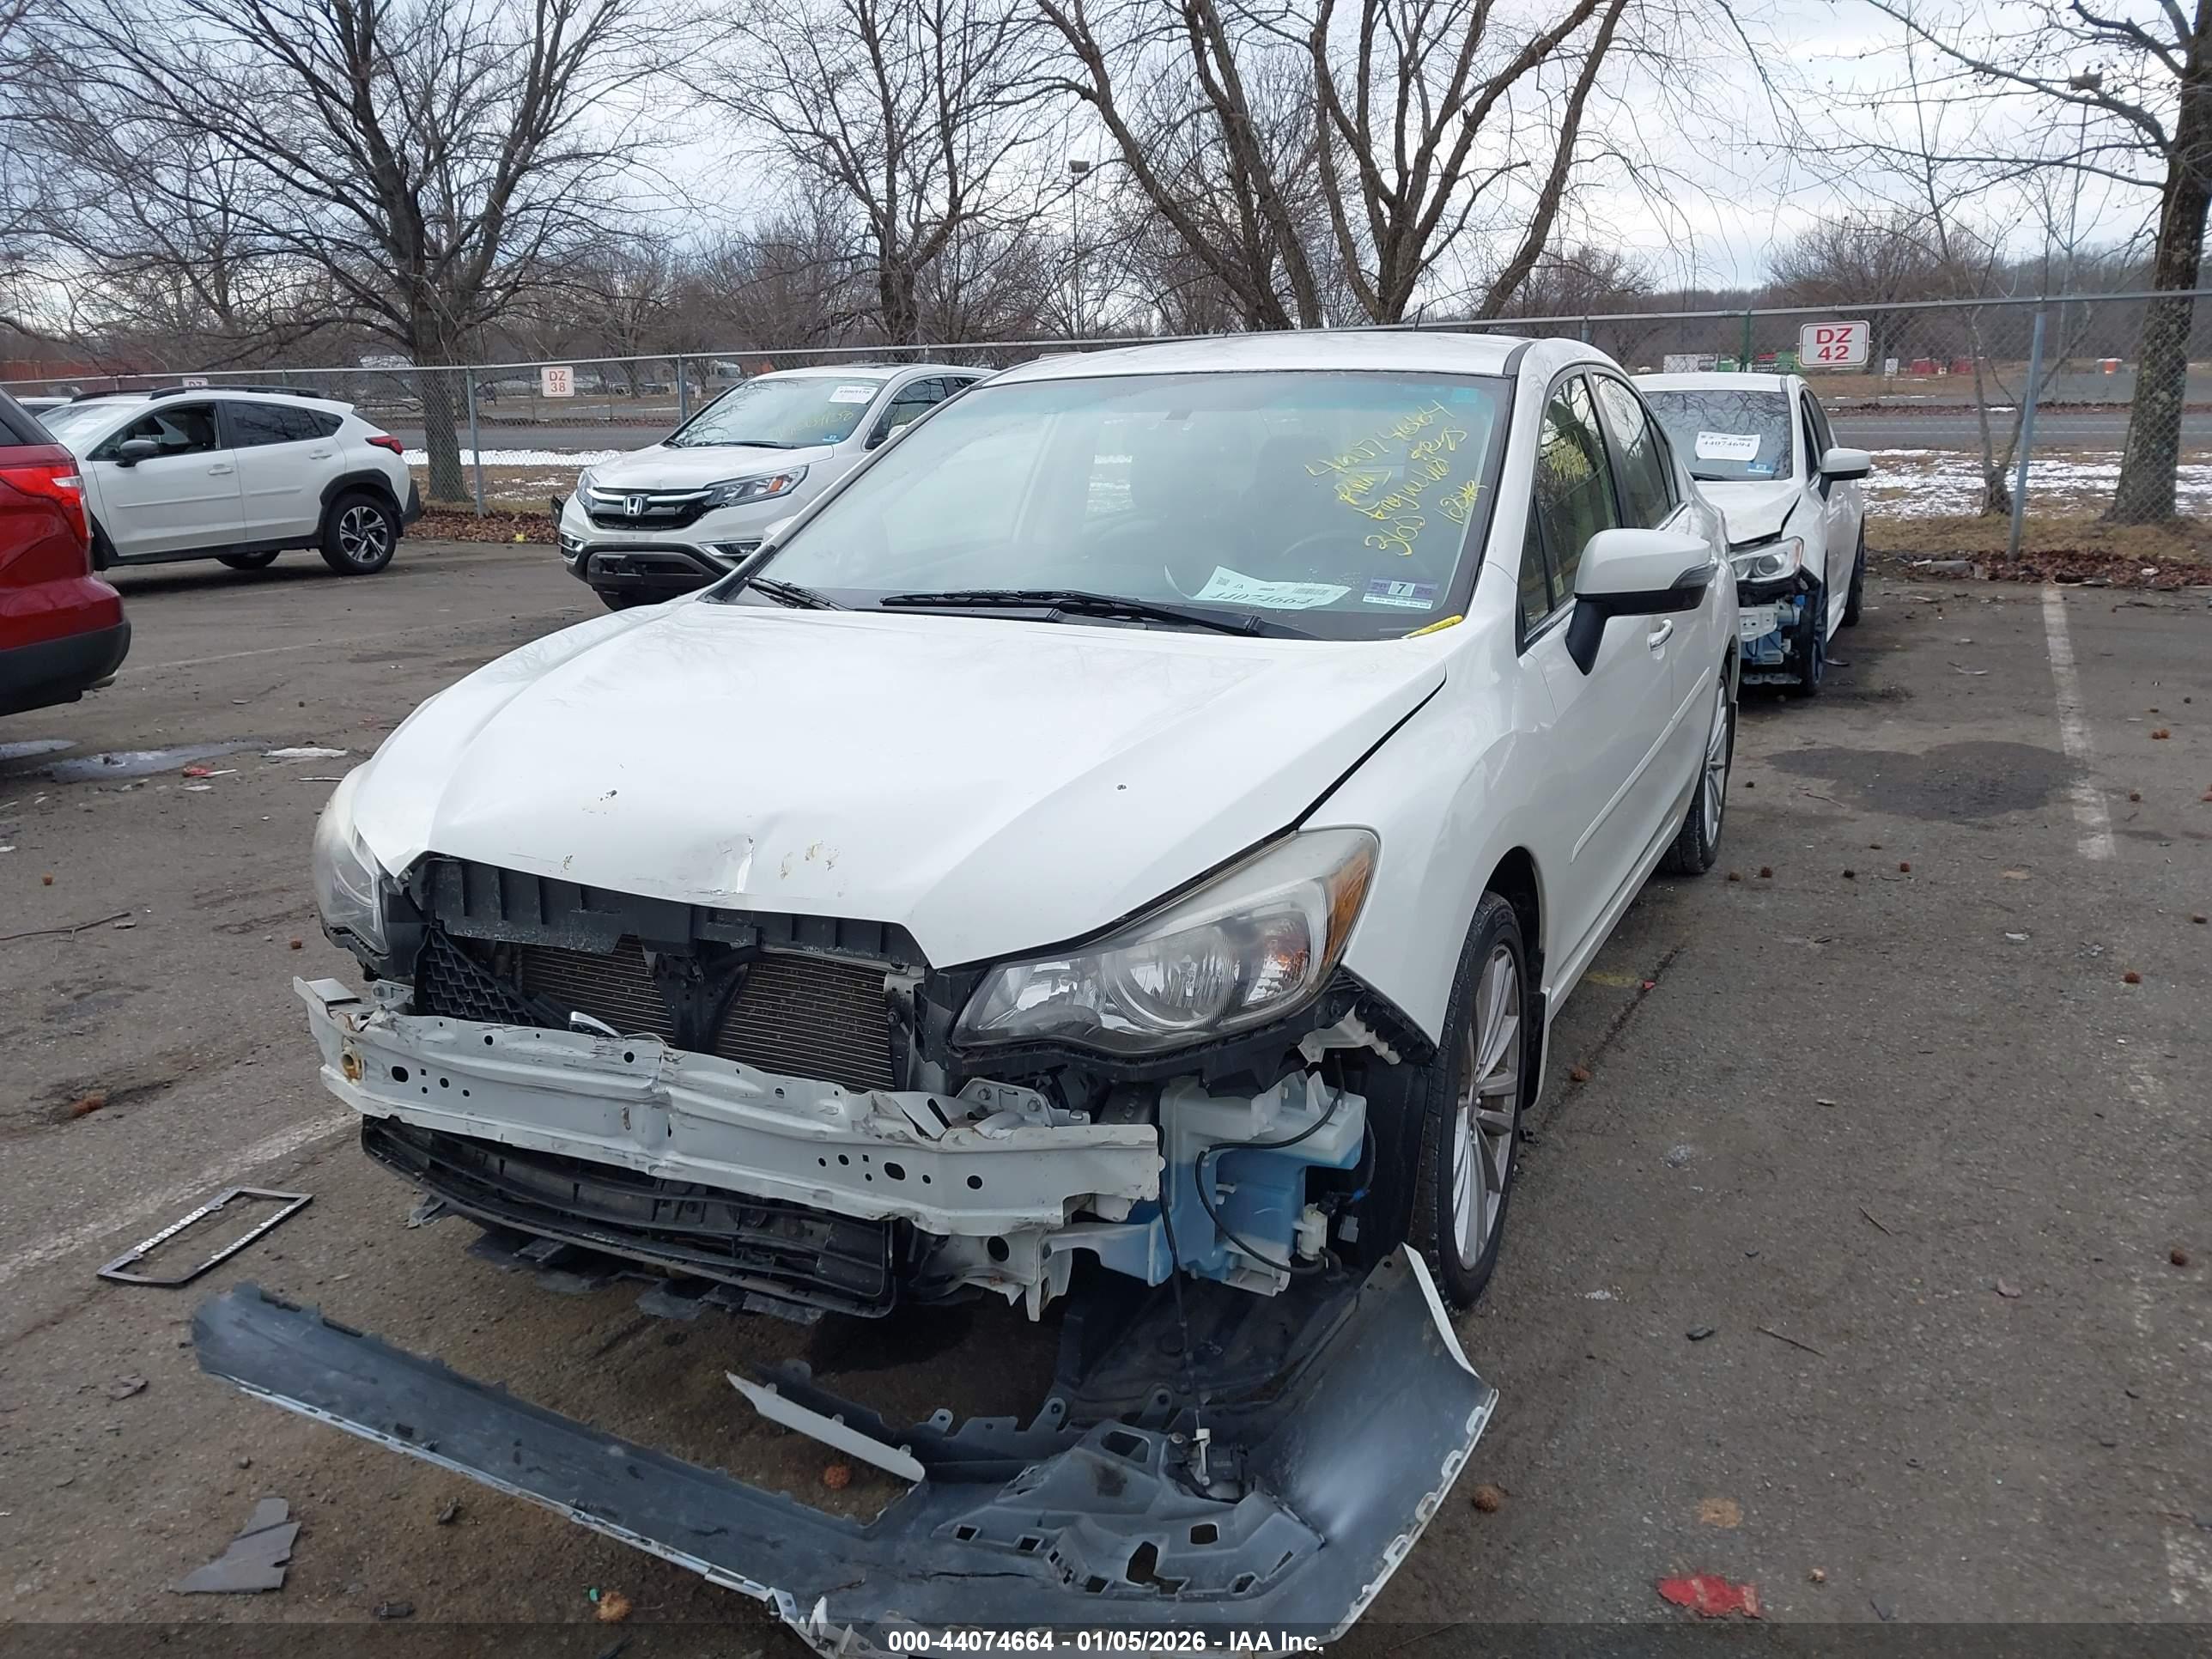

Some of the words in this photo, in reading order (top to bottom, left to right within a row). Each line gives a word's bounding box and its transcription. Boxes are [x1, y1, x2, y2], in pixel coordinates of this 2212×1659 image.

[1816, 327, 1853, 344] DZ
[1817, 345, 1850, 361] 42
[549, 370, 567, 381] DZ
[550, 382, 566, 392] 38
[1396, 583, 1407, 594] 7
